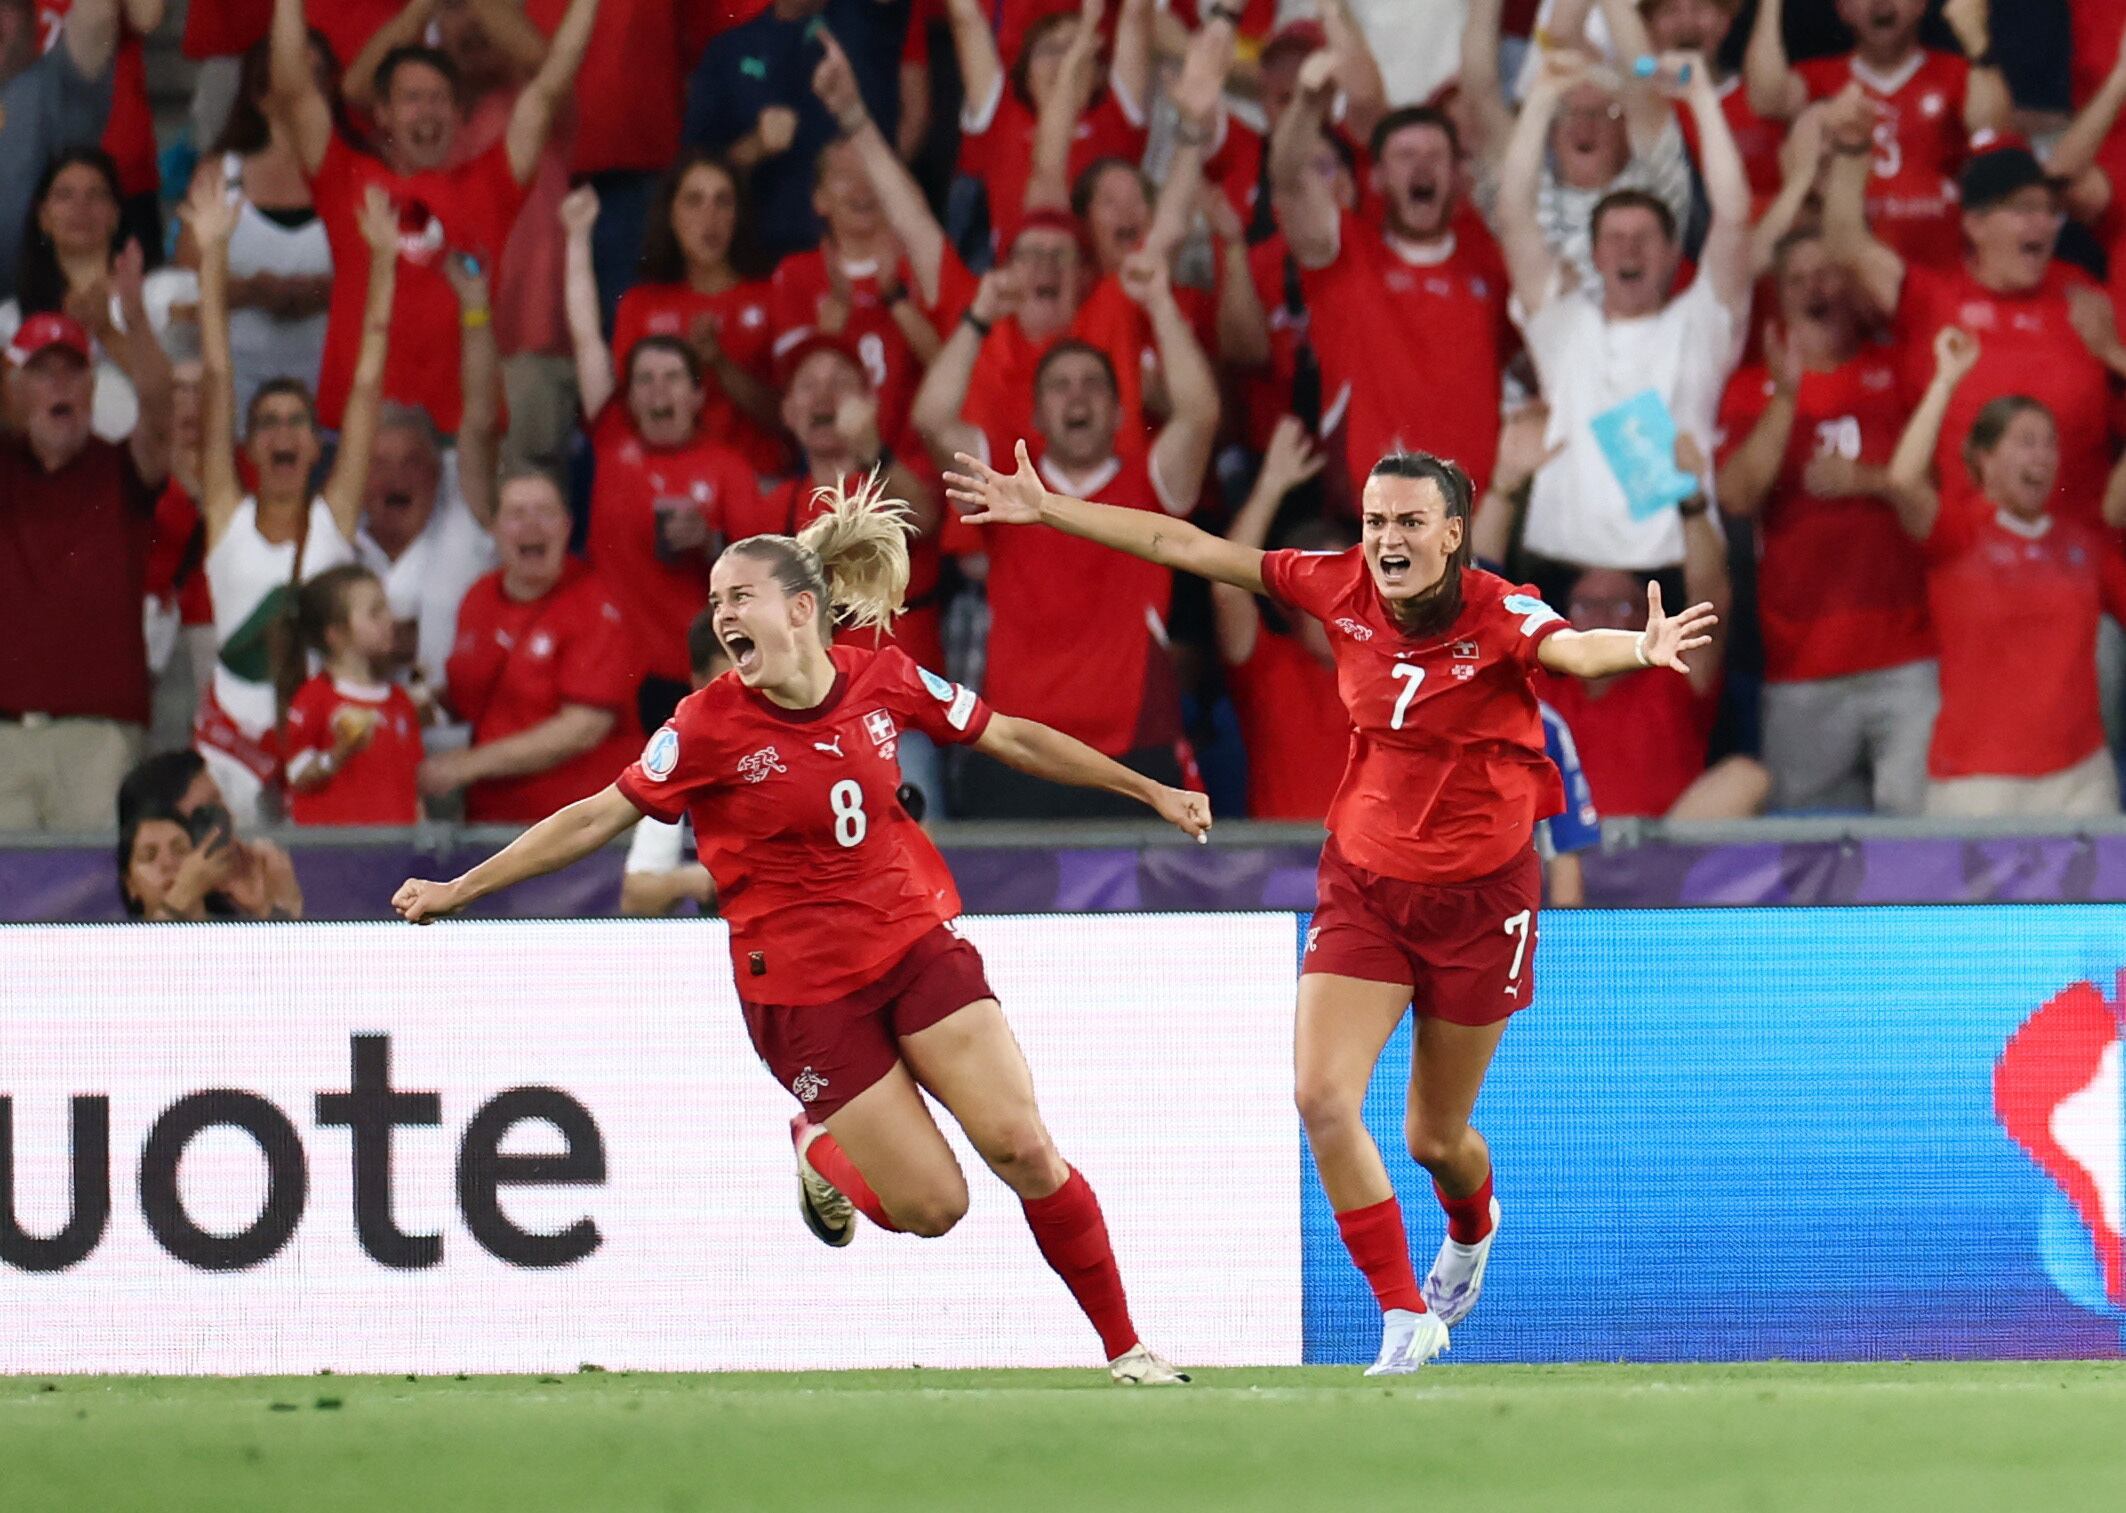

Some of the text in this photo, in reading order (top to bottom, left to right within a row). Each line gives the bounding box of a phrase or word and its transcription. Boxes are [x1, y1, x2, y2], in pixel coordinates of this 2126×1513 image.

[1390, 662, 1426, 731] 7
[829, 778, 867, 848] 8
[1503, 908, 1532, 981] 7
[0, 1031, 606, 1272] uote
